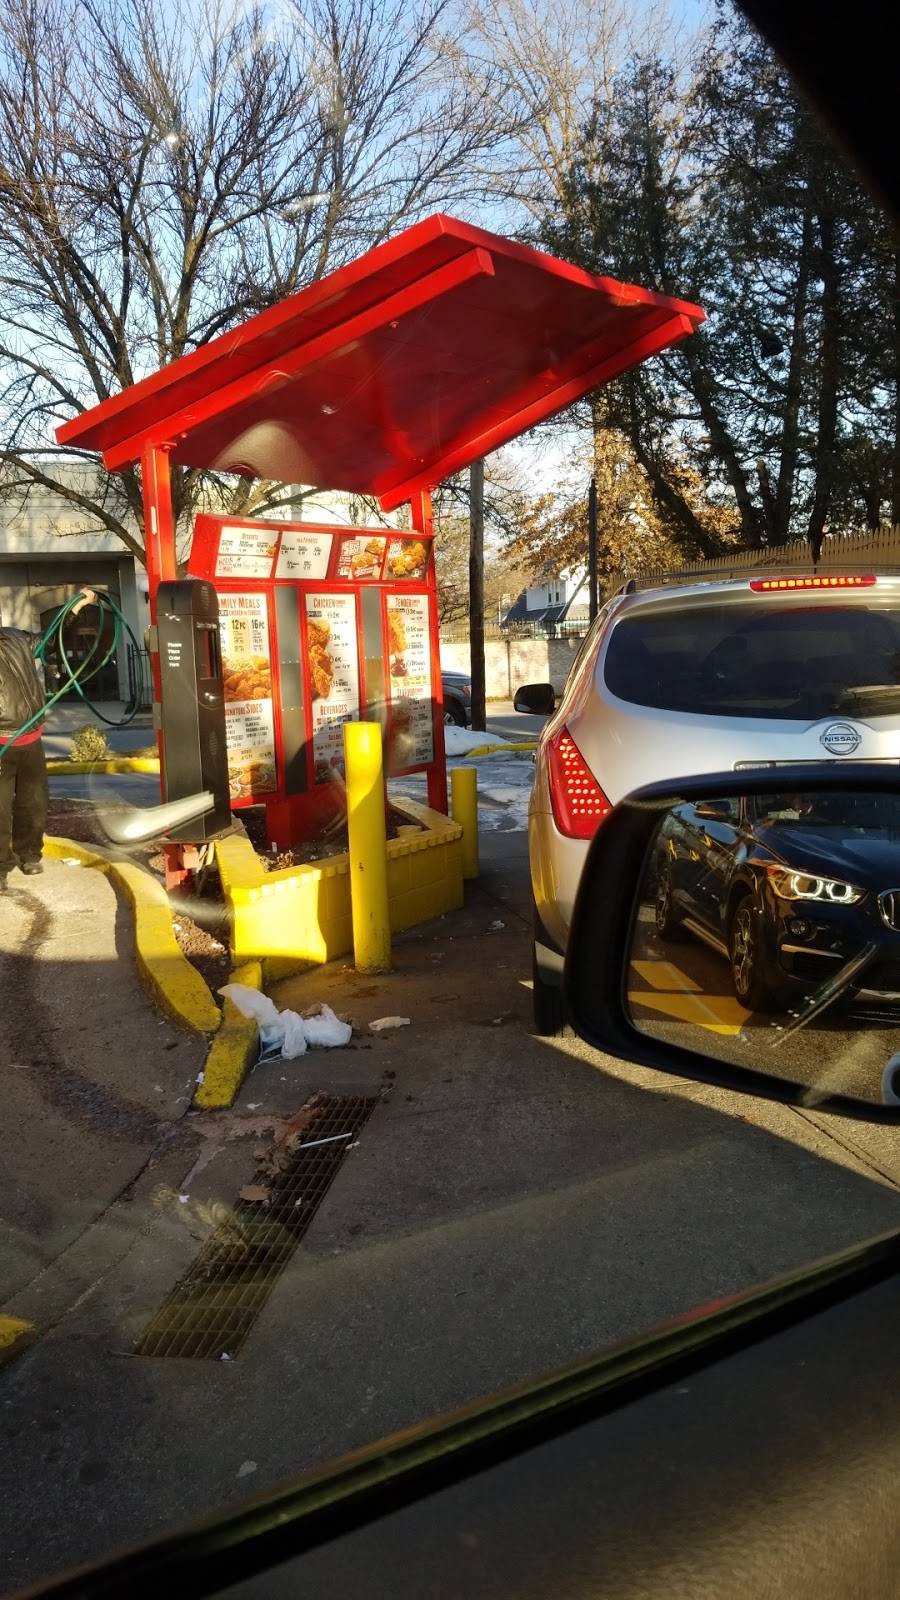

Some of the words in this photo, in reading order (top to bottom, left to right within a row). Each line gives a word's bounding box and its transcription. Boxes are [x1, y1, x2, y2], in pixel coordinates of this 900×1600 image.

[238, 597, 261, 609] MEALS
[313, 597, 336, 608] CHICKEN
[245, 703, 263, 714] SIDES
[320, 703, 348, 715] BEVERAGES
